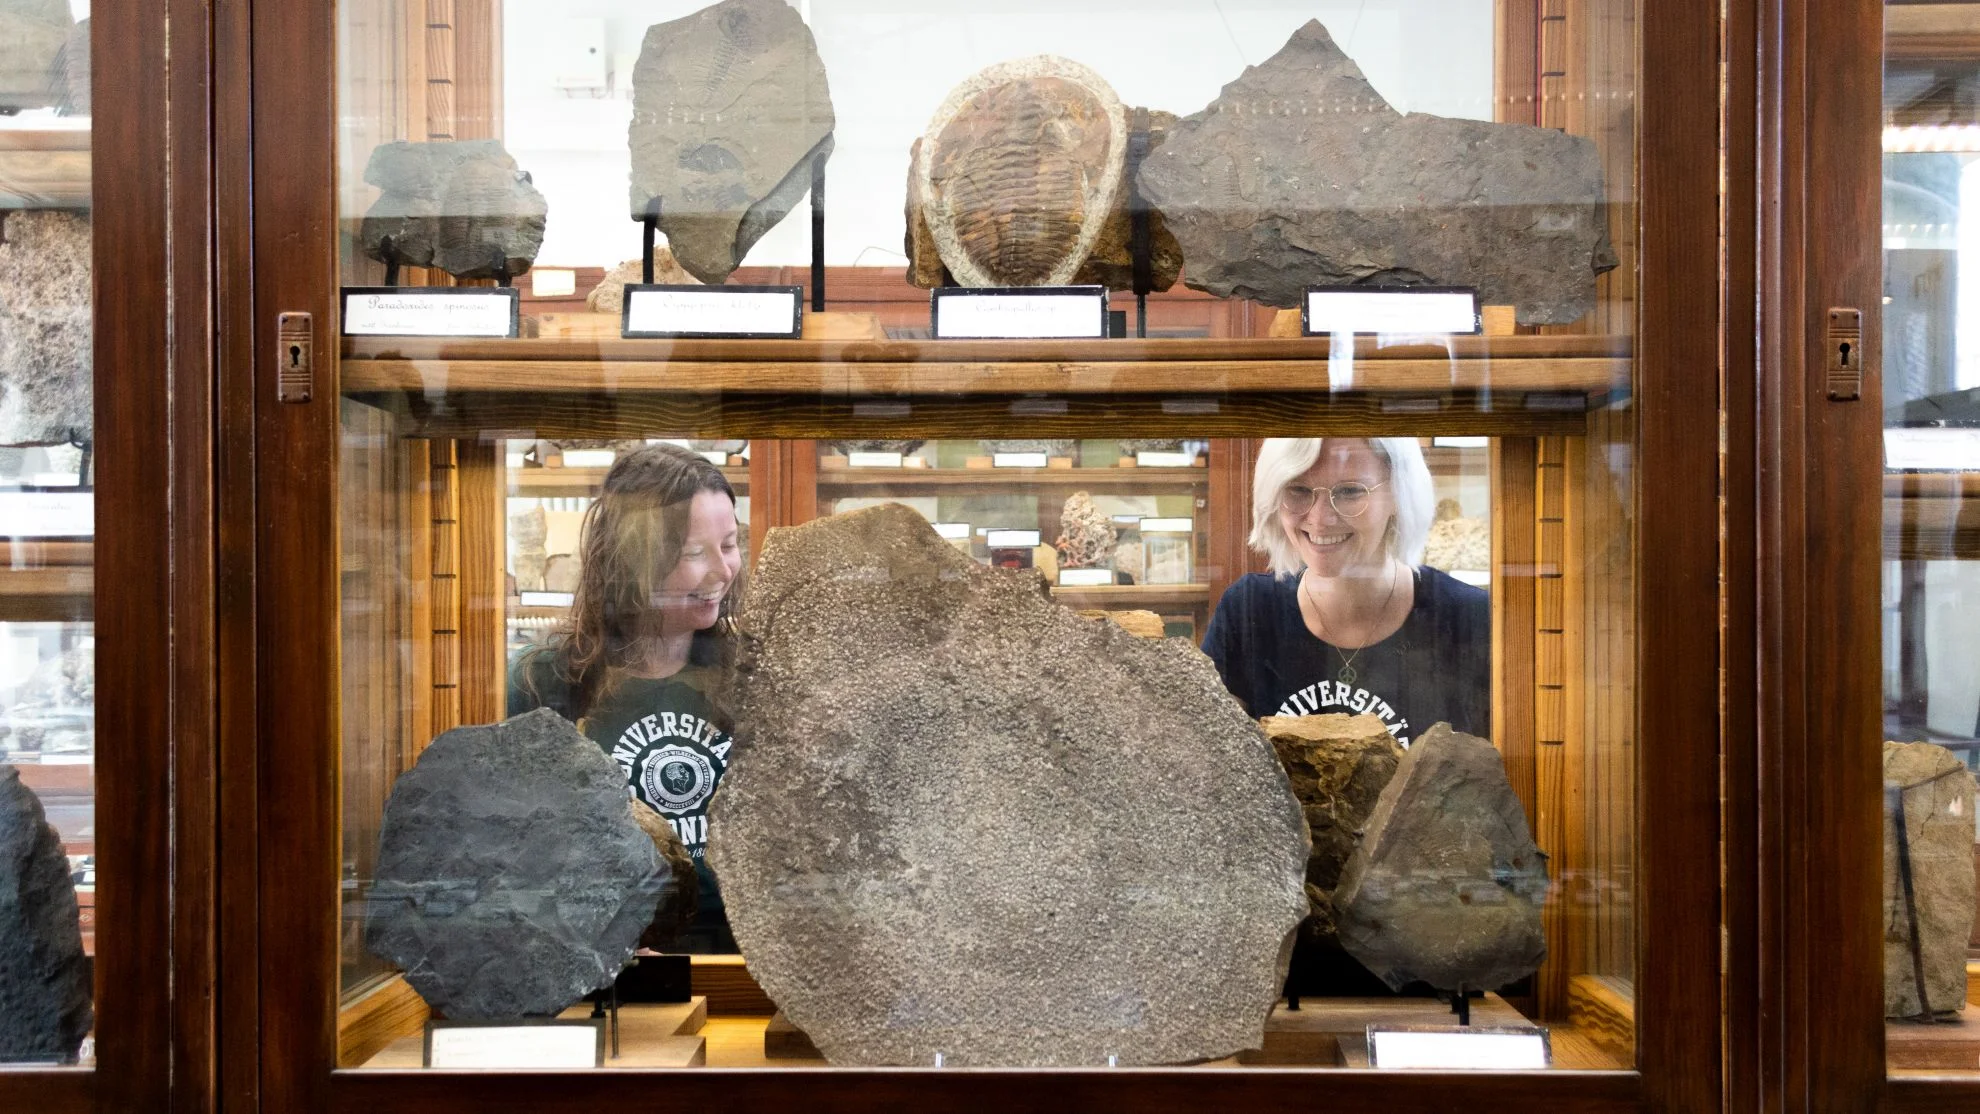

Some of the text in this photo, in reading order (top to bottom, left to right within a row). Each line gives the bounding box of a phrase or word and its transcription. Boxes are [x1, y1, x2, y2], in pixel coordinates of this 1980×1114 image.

[368, 295, 434, 310] Paradoxides
[1275, 680, 1410, 751] NIVERSITÄ
[612, 711, 733, 780] NIVERSITÄ
[666, 815, 708, 845] NN
